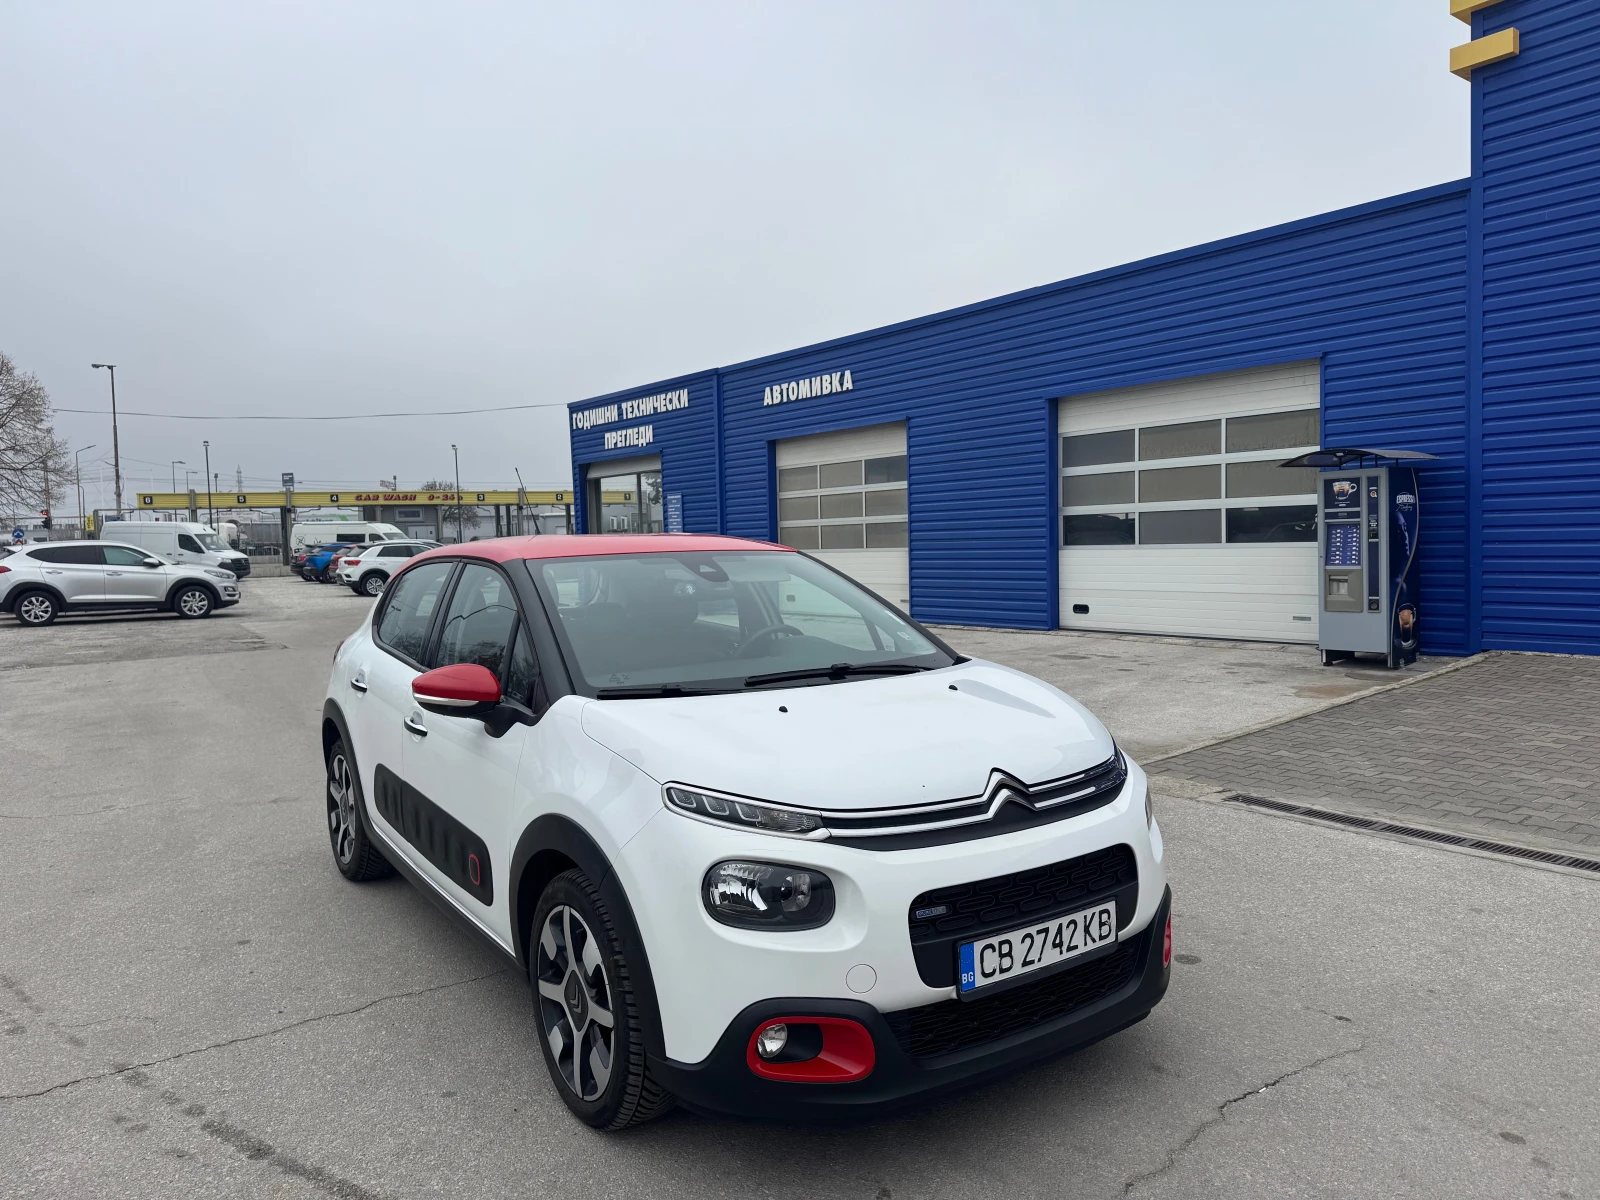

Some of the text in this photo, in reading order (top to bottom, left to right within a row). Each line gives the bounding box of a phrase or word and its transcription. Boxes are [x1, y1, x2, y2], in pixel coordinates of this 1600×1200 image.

[763, 370, 853, 406] АВТОМИВКА
[572, 389, 688, 430] ГОДИШНИ ТЕХНИЧЕСКИ
[605, 425, 653, 449] ПРЕГЛЕДИ
[979, 908, 1112, 978] CB 2742 KB
[962, 971, 974, 984] BG
